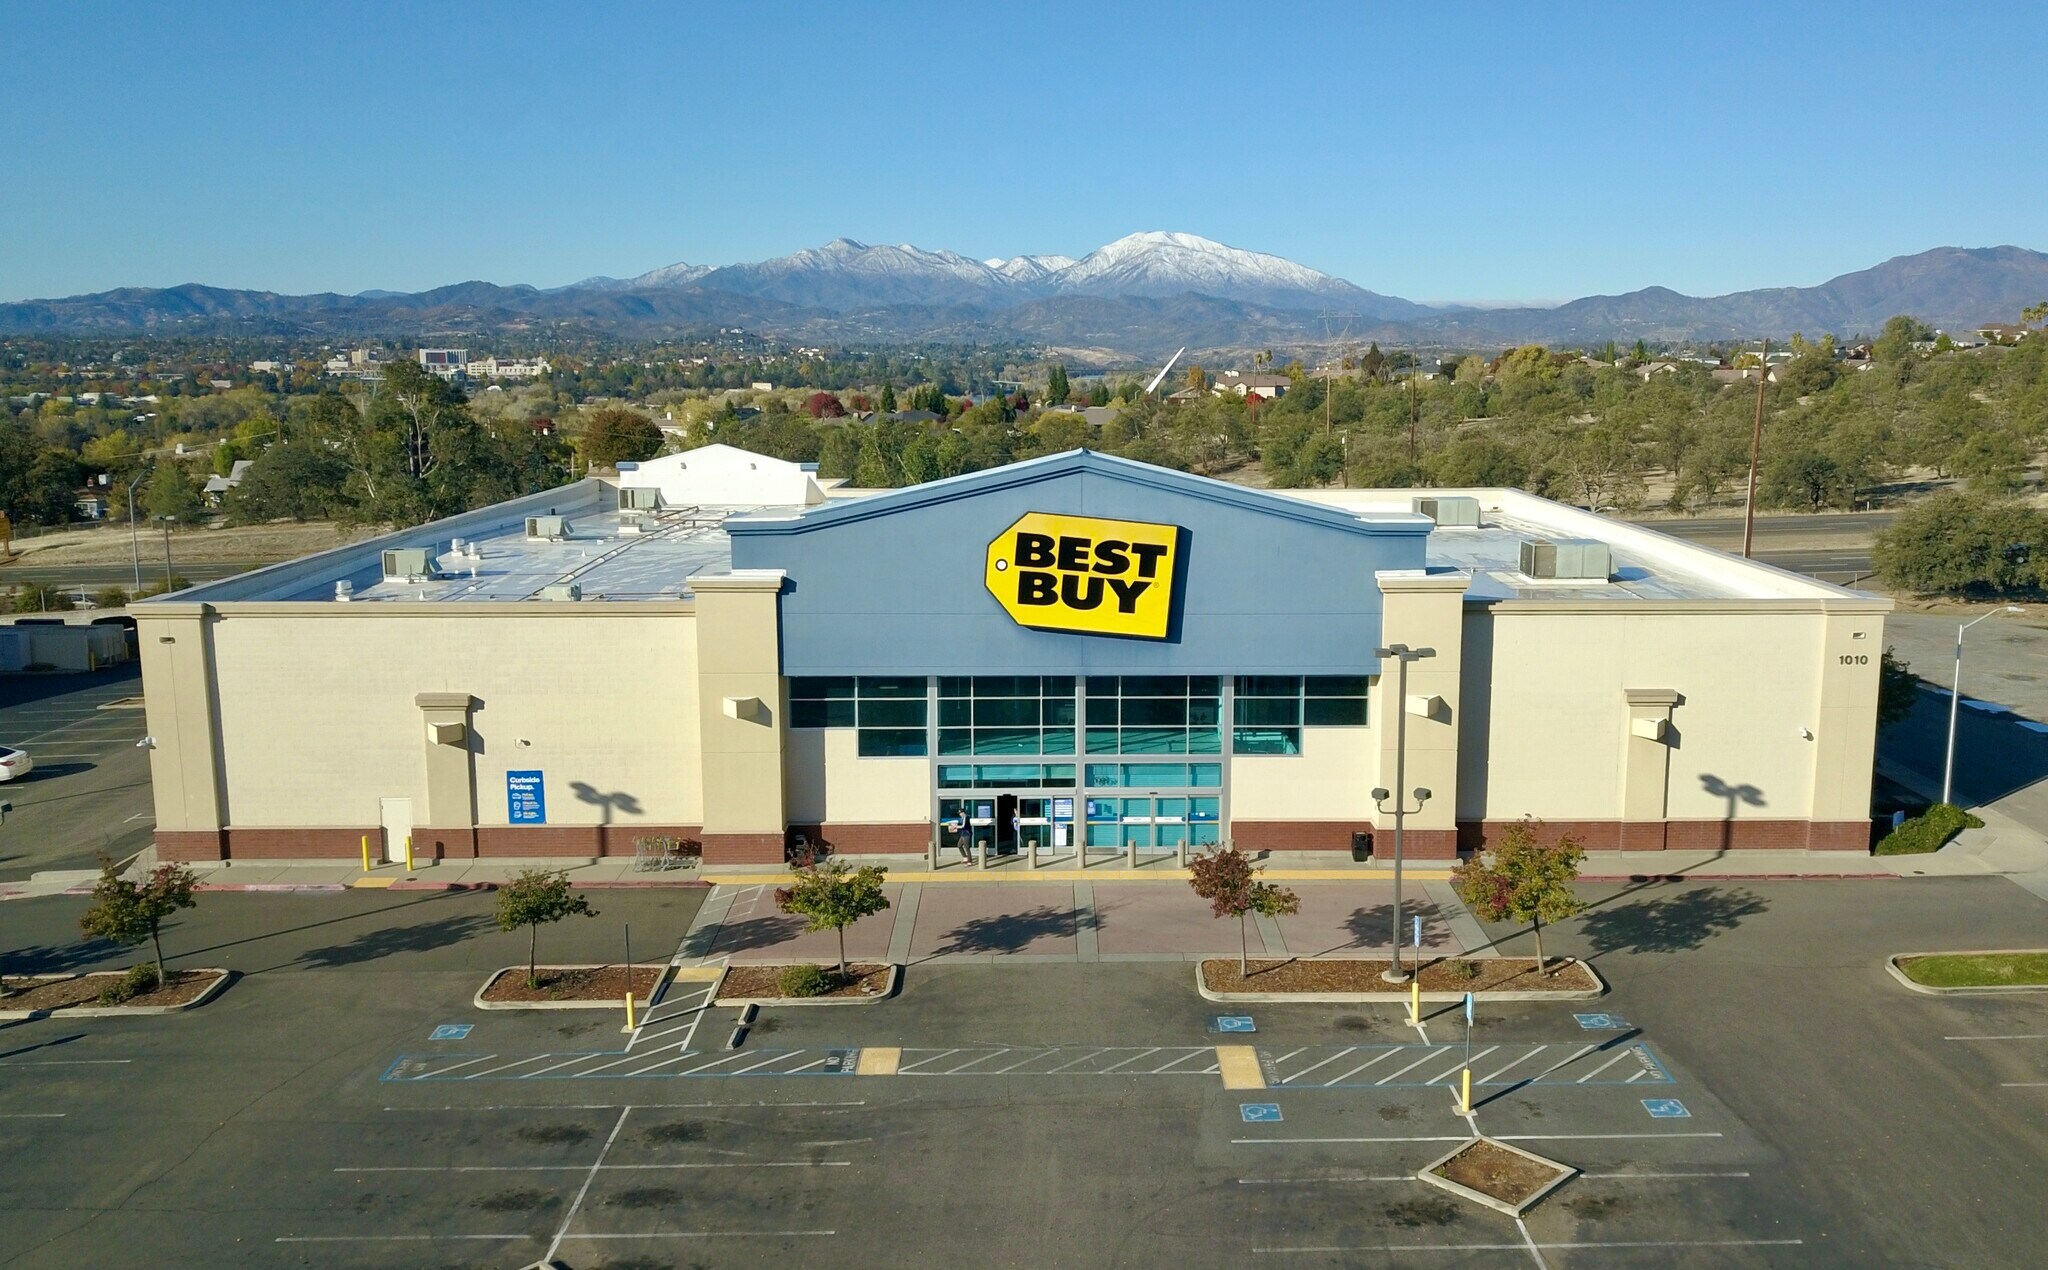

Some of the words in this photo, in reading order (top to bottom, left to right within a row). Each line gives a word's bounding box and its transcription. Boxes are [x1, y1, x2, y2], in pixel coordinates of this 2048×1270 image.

[1015, 532, 1168, 578] BEST
[1018, 571, 1152, 614] BUY
[1839, 655, 1868, 665] 1010
